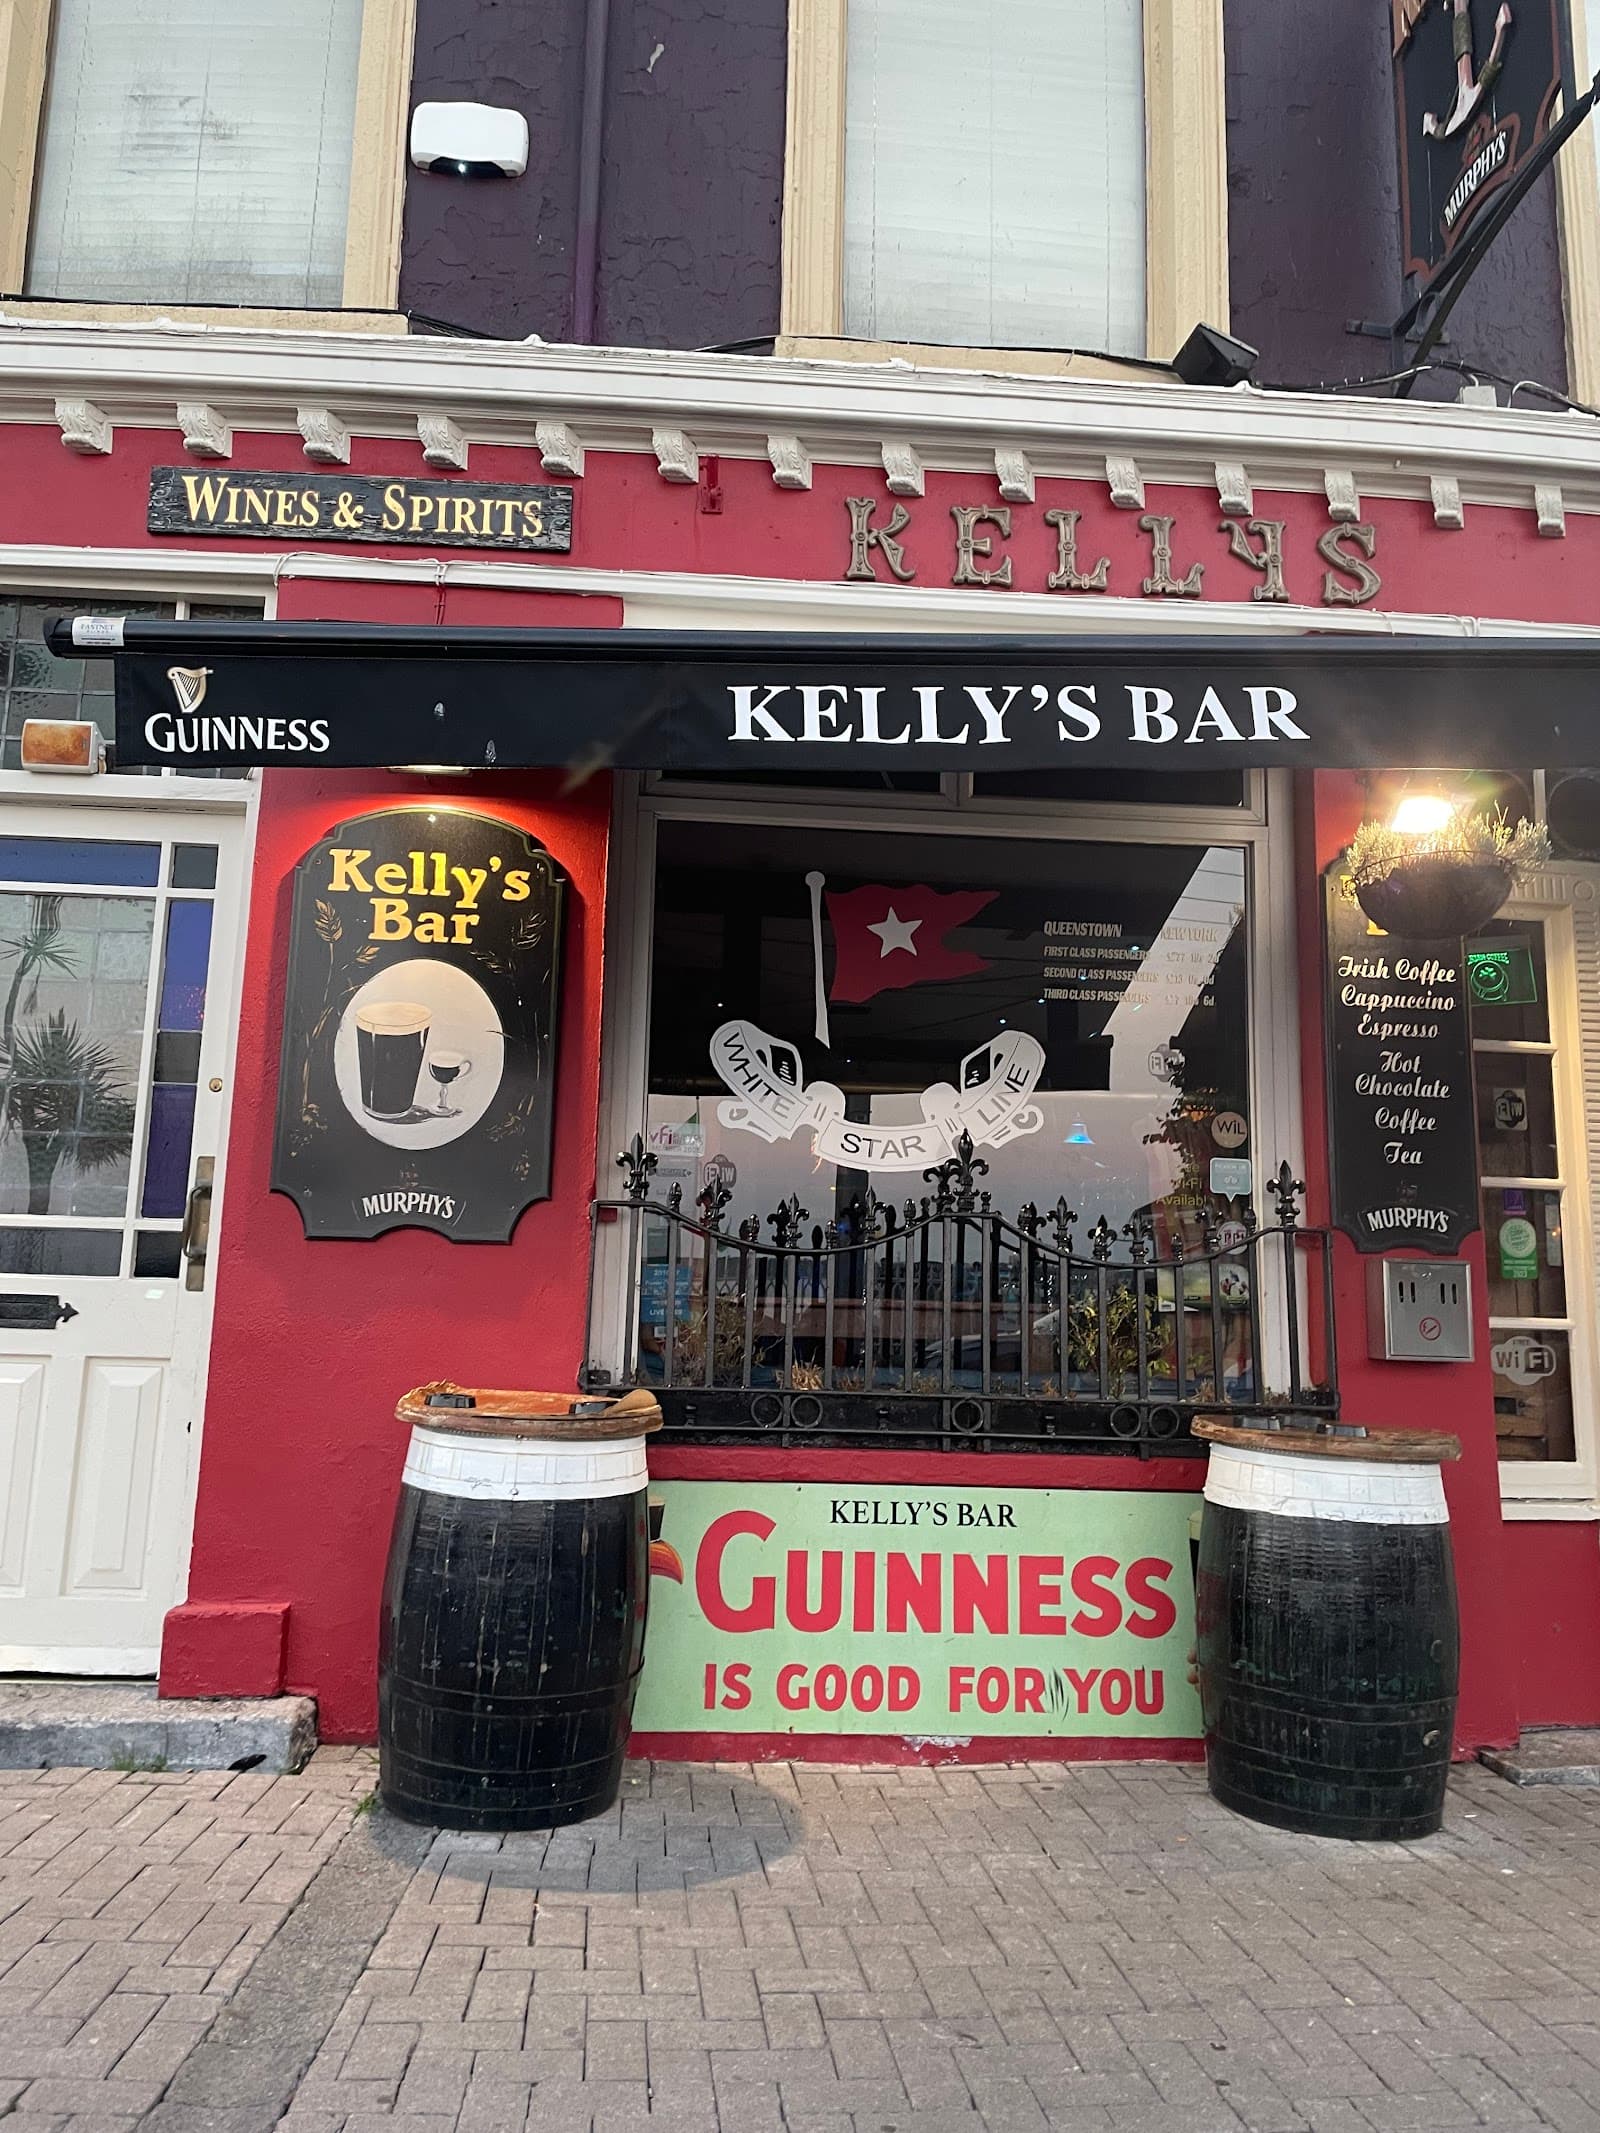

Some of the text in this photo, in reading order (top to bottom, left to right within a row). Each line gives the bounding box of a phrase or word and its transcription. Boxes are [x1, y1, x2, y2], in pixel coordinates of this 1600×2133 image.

[1443, 130, 1507, 226] MURPHY'S
[181, 474, 543, 538] WINES & SPIRITS
[844, 497, 1382, 604] KELLYS
[726, 684, 1311, 745] KELLY'S BAR
[144, 713, 330, 753] GUINNESS
[327, 848, 531, 909] Kelly's
[368, 897, 481, 944] Bar
[1044, 921, 1122, 938] QUEENSTOWN
[1044, 945, 1069, 957] FIRST
[1069, 947, 1097, 958] CLASS
[1097, 948, 1151, 961] PASSENGERS
[1043, 966, 1077, 979] SECOND
[1077, 968, 1105, 980] CLASS
[1337, 955, 1457, 985] Irish Coffee
[1043, 987, 1069, 999] THIRD
[1069, 989, 1097, 1001] CLASS
[1203, 995, 1215, 1006] 6d
[1341, 984, 1456, 1012] Cappuccino
[1357, 1013, 1440, 1041] Espresso
[1380, 1051, 1421, 1073] Hot
[722, 1031, 1030, 1160] WHITE STAR LINE
[1355, 1073, 1451, 1098] Chocolate
[1375, 1106, 1437, 1134] Coffee
[1383, 1141, 1424, 1165] Tea
[361, 1191, 456, 1219] MURPHY'S
[1156, 1193, 1210, 1207] Availabl
[1366, 1207, 1449, 1233] MURPHY'S
[829, 1499, 1017, 1528] KELLY'S BAR
[695, 1509, 1178, 1640] GUINNESS
[703, 1663, 1165, 1716] IS GOOD FOR YOU
